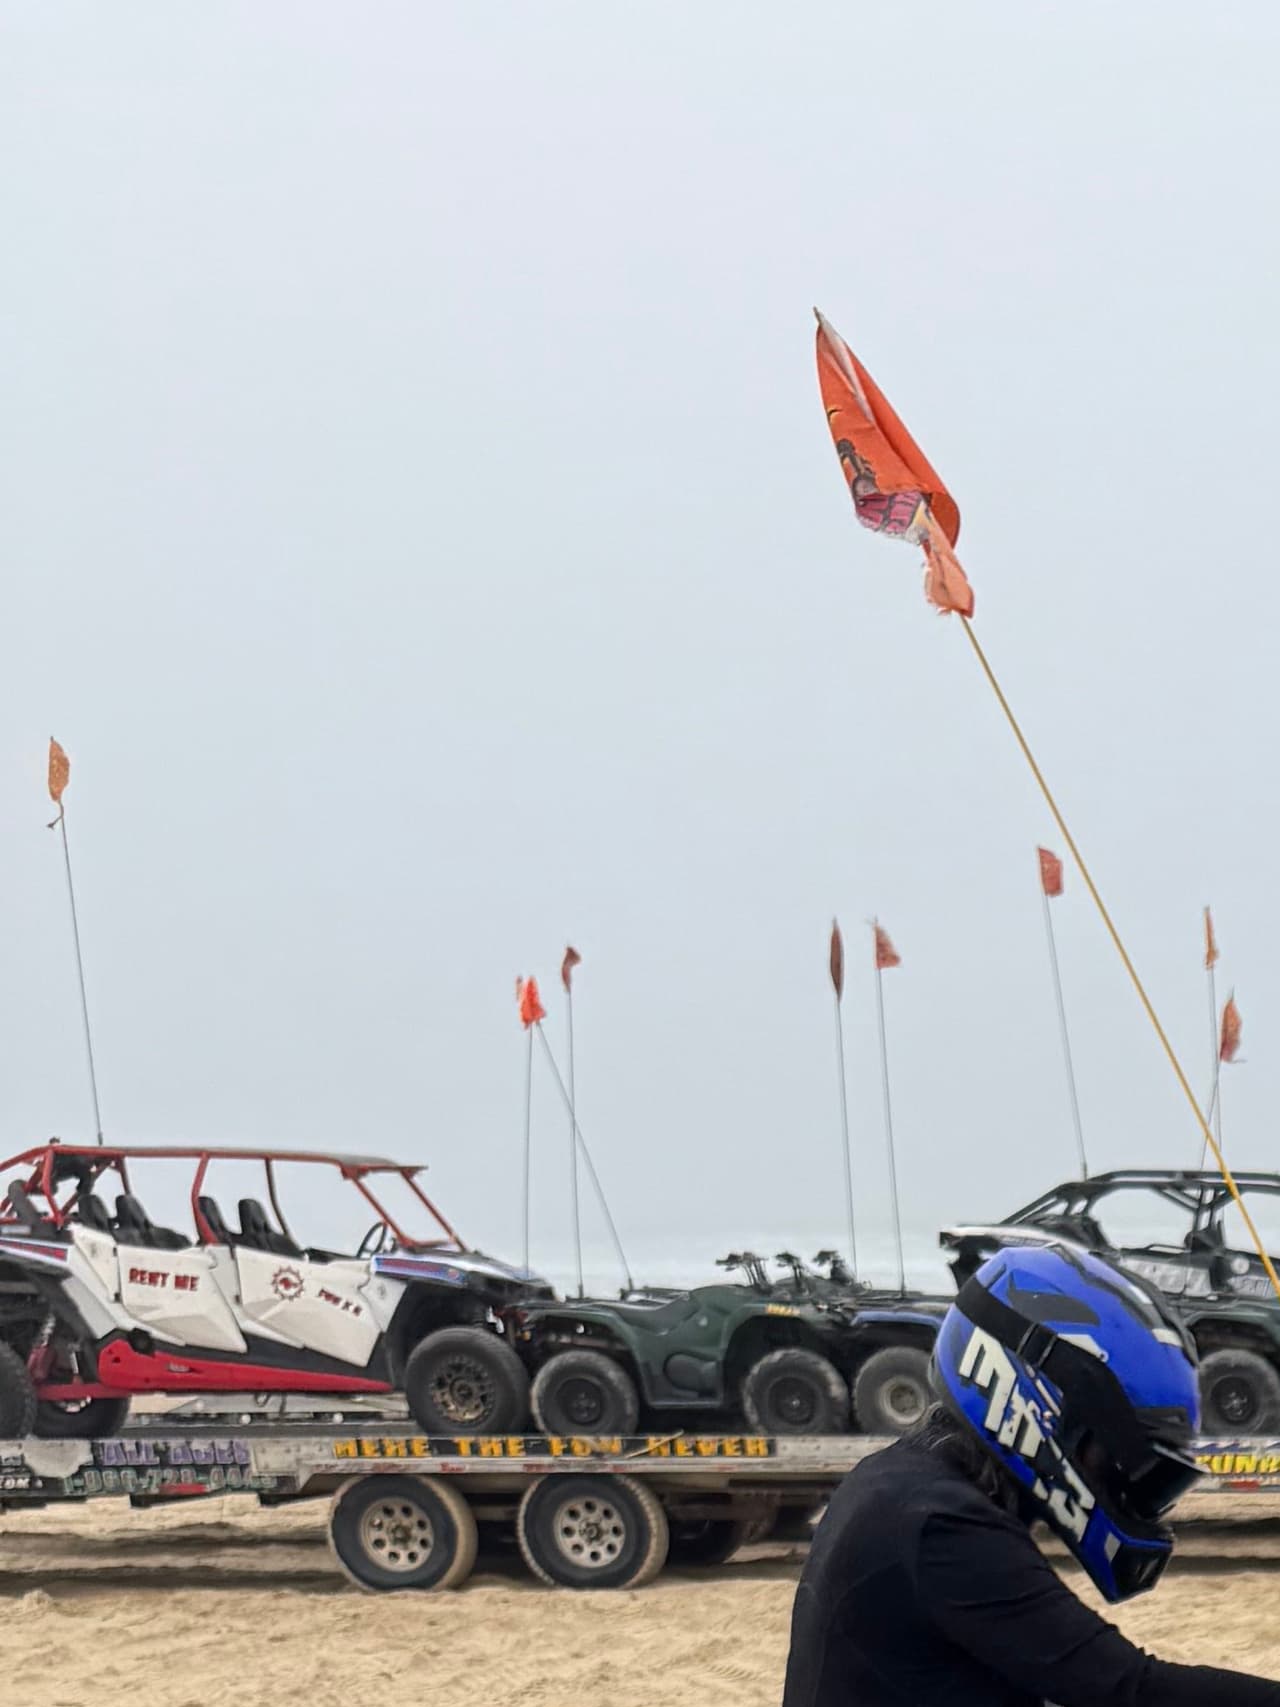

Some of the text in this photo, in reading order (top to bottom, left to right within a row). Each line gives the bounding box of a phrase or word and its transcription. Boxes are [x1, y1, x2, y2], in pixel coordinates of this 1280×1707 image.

[129, 1268, 200, 1291] RENT ME
[103, 1439, 160, 1465] ALL
[454, 1436, 526, 1457] THE
